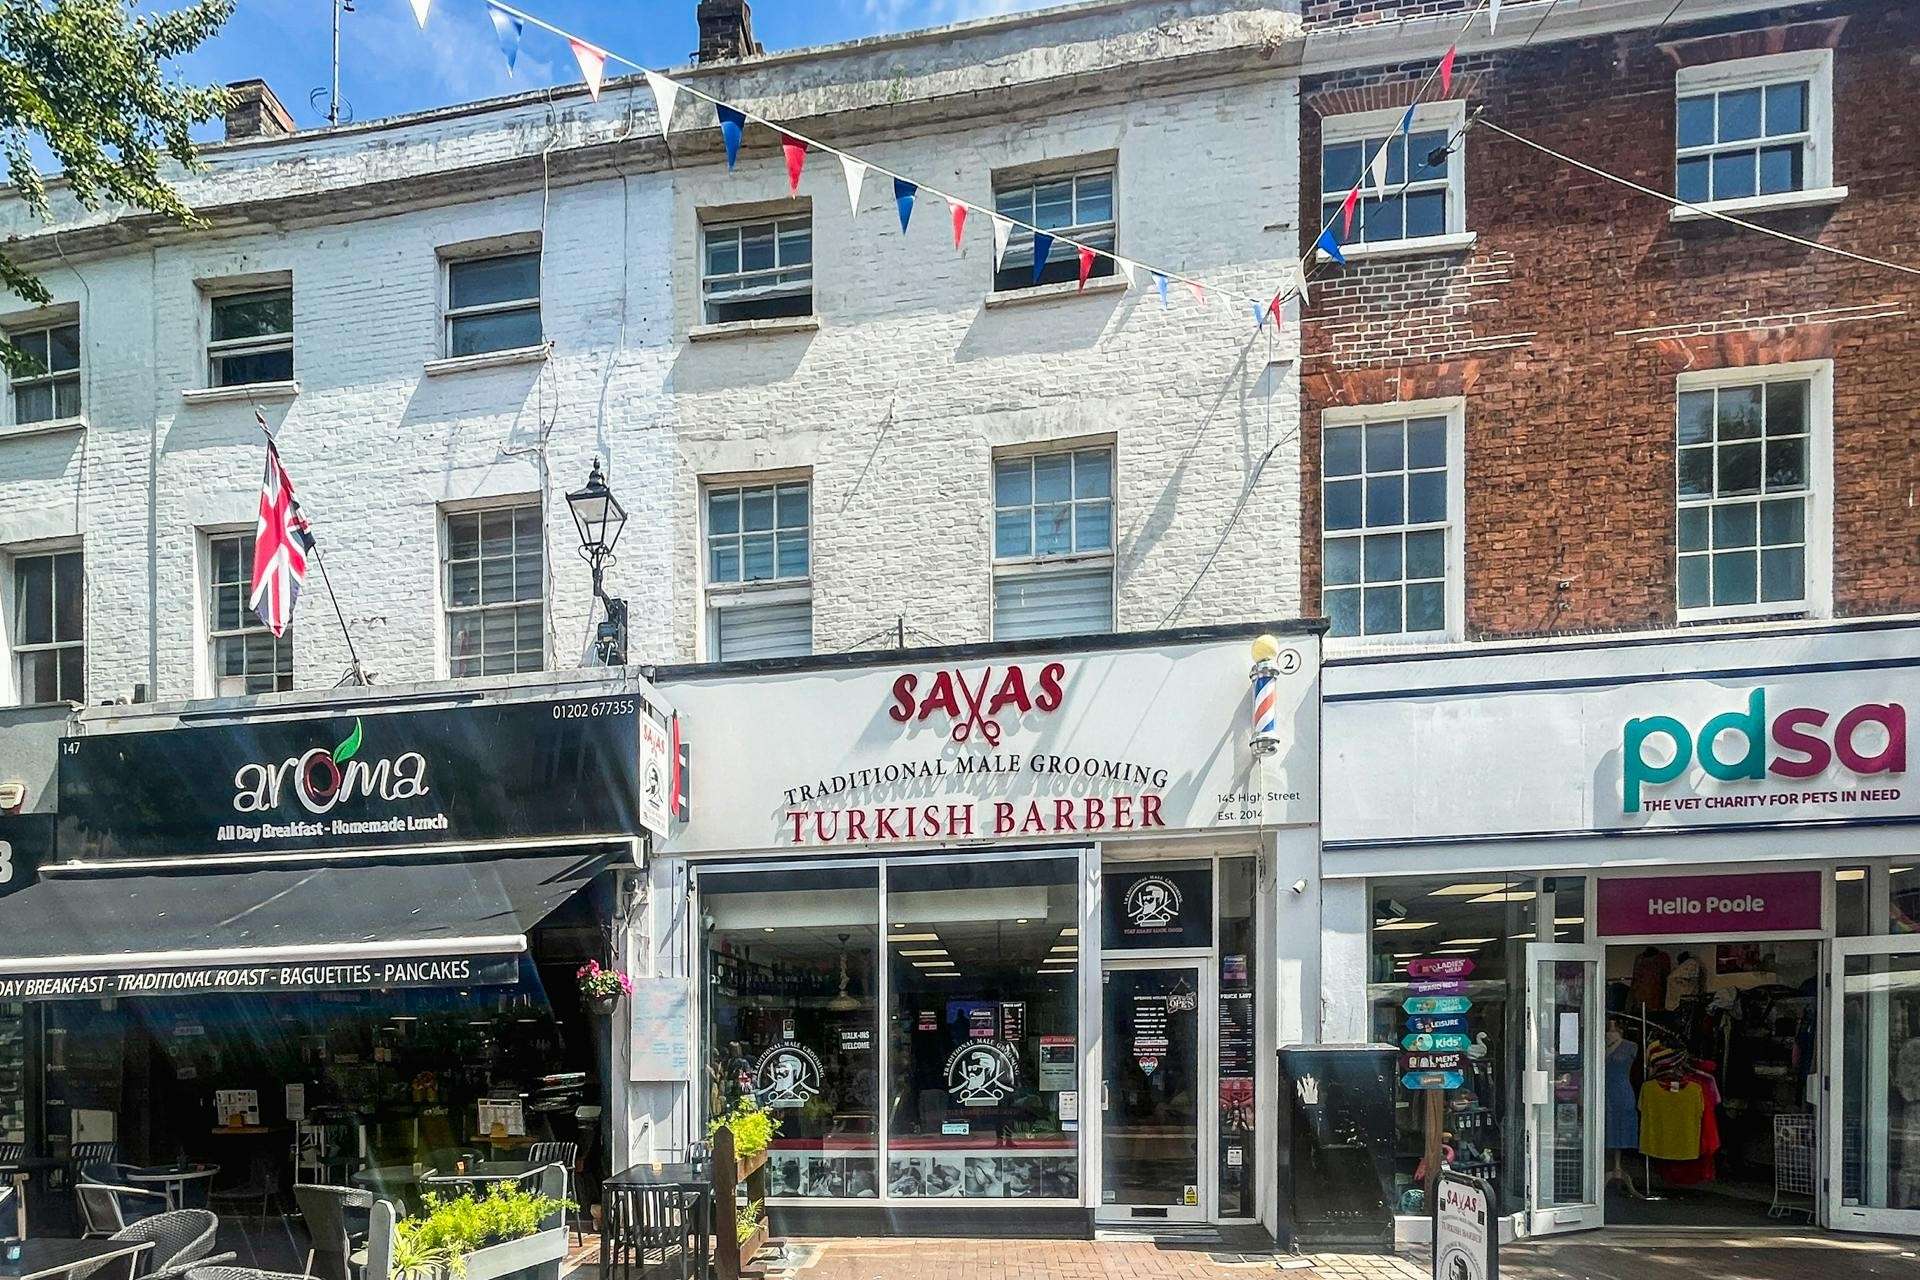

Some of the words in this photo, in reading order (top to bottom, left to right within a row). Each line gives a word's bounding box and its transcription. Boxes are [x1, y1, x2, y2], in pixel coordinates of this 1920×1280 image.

[1283, 654, 1294, 669] 2
[553, 703, 588, 719] 01202
[591, 700, 634, 716] 677355
[889, 663, 1065, 746] SAVAS
[63, 742, 80, 754] 147
[1624, 687, 1906, 813] pdsa
[784, 759, 947, 806] TRADITIONAL
[957, 755, 1020, 774] MALE
[1030, 755, 1169, 788] GROOMING
[1217, 794, 1235, 804] 145
[1238, 793, 1263, 806] High
[1267, 792, 1300, 801] Street
[1643, 800, 1671, 812] THE
[1674, 798, 1702, 810] VET
[1704, 795, 1767, 809] CHARITY
[1769, 793, 1799, 806] FOR
[1802, 791, 1838, 804] PETS
[1841, 789, 1857, 801] IN
[1860, 788, 1901, 801] NEED
[786, 804, 974, 842] TURKISH
[994, 795, 1166, 834] BARBER
[1217, 812, 1236, 821] Est.
[1240, 809, 1263, 820] 2014
[217, 826, 234, 841] All
[236, 825, 261, 842] Day
[262, 822, 324, 838] Breakfast
[332, 817, 405, 834] Homemade
[407, 813, 448, 830] Lunch
[1648, 897, 1701, 916] Hello
[1706, 895, 1765, 914] Poole
[25, 976, 108, 995] BREAKFAST
[117, 971, 212, 991] TRADITIONAL
[215, 968, 268, 986] ROAST
[280, 965, 371, 985] BAGUETTES
[384, 960, 470, 982] PANCAKES
[1169, 1000, 1194, 1008] OPEN
[1431, 1019, 1459, 1028] LEISURE
[842, 1042, 870, 1050] WELCOME
[943, 1040, 974, 1076] TRADITIONAL
[996, 1042, 1020, 1076] GROOMING
[802, 1046, 825, 1078] GROOMING
[1447, 1190, 1477, 1216] SAVAS
